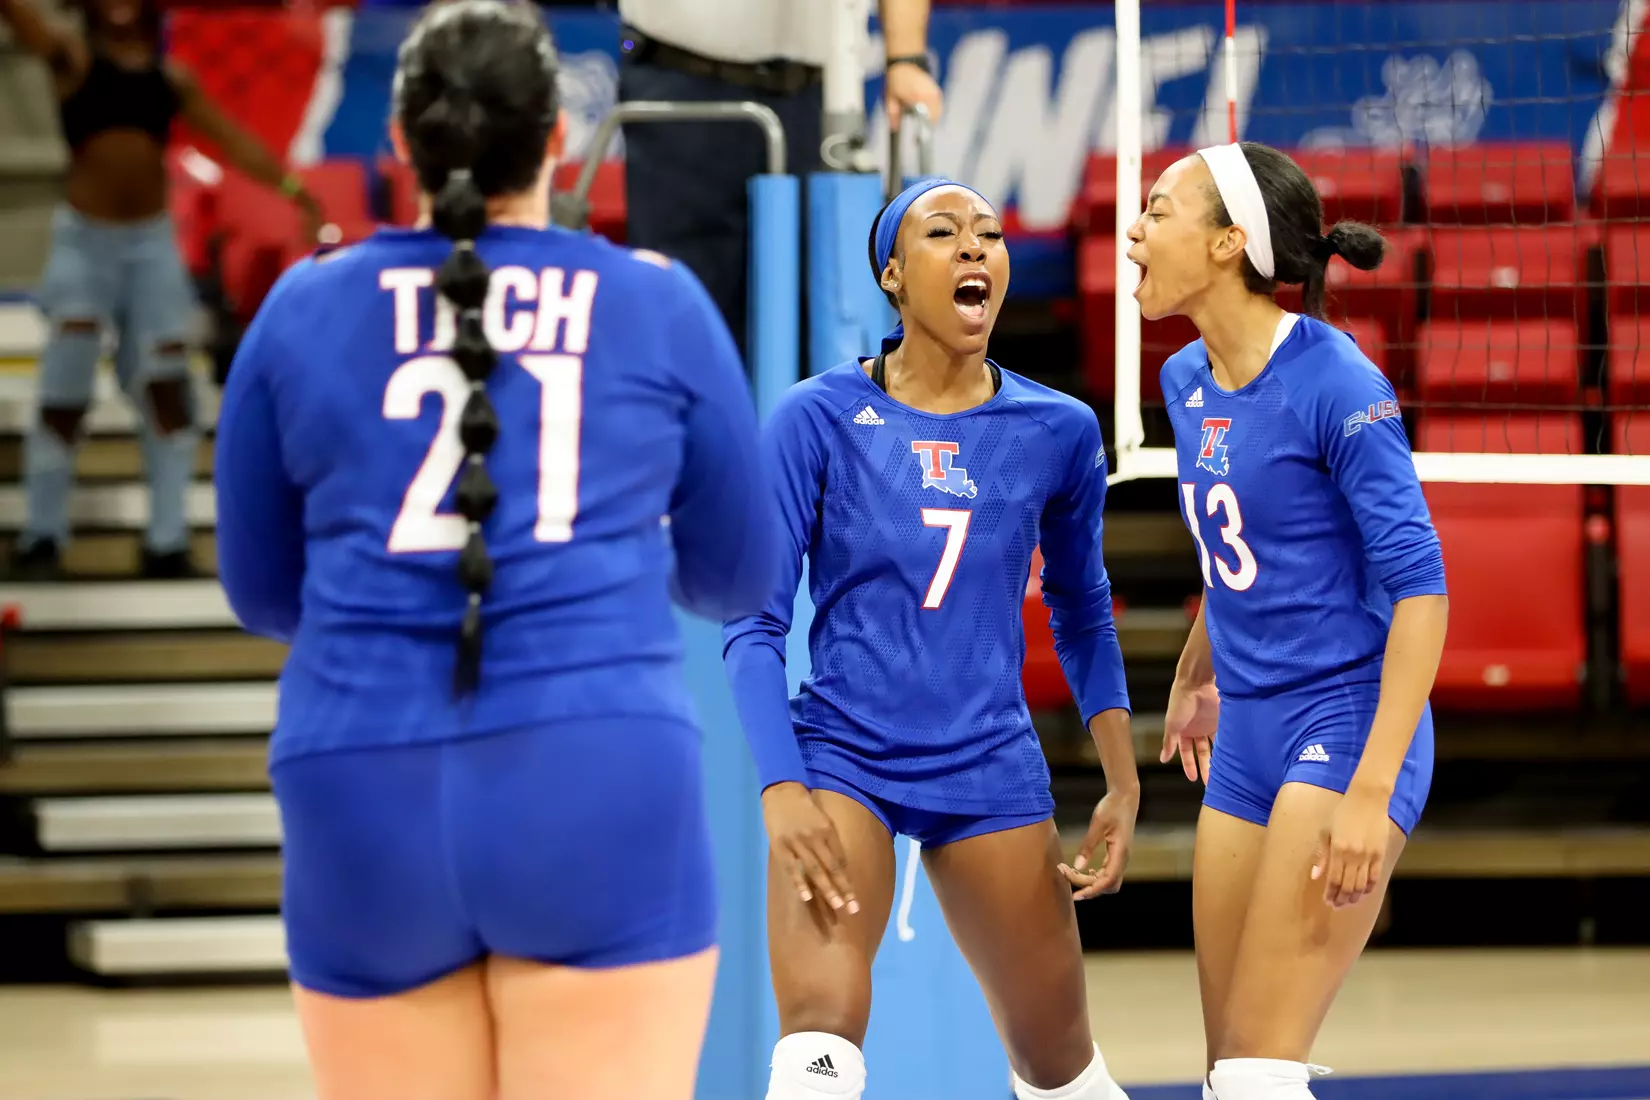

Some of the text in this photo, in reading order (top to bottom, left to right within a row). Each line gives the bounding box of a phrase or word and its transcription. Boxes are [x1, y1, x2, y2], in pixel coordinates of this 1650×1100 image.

[853, 417, 885, 425] adidas
[381, 354, 583, 553] 21
[920, 507, 973, 610] 7
[1181, 482, 1258, 592] 13
[1298, 754, 1330, 762] adidas
[806, 1065, 839, 1078] adidas
